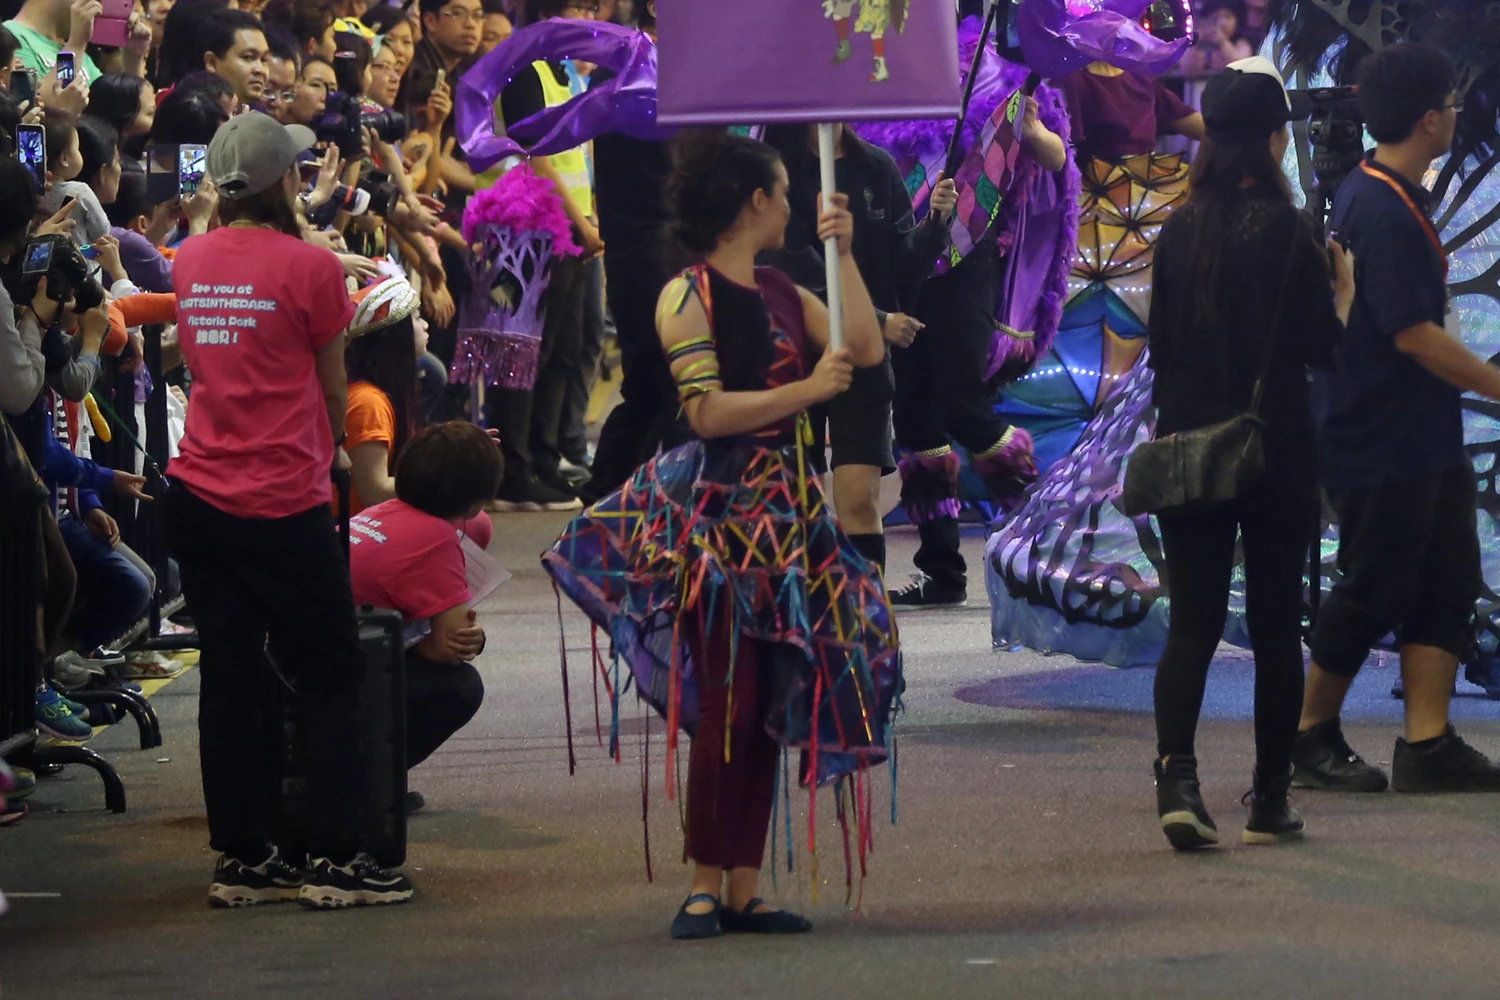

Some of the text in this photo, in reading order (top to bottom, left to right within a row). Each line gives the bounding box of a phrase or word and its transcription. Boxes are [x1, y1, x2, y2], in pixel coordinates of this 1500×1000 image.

[191, 282, 254, 295] See you at
[228, 316, 257, 328] Park
